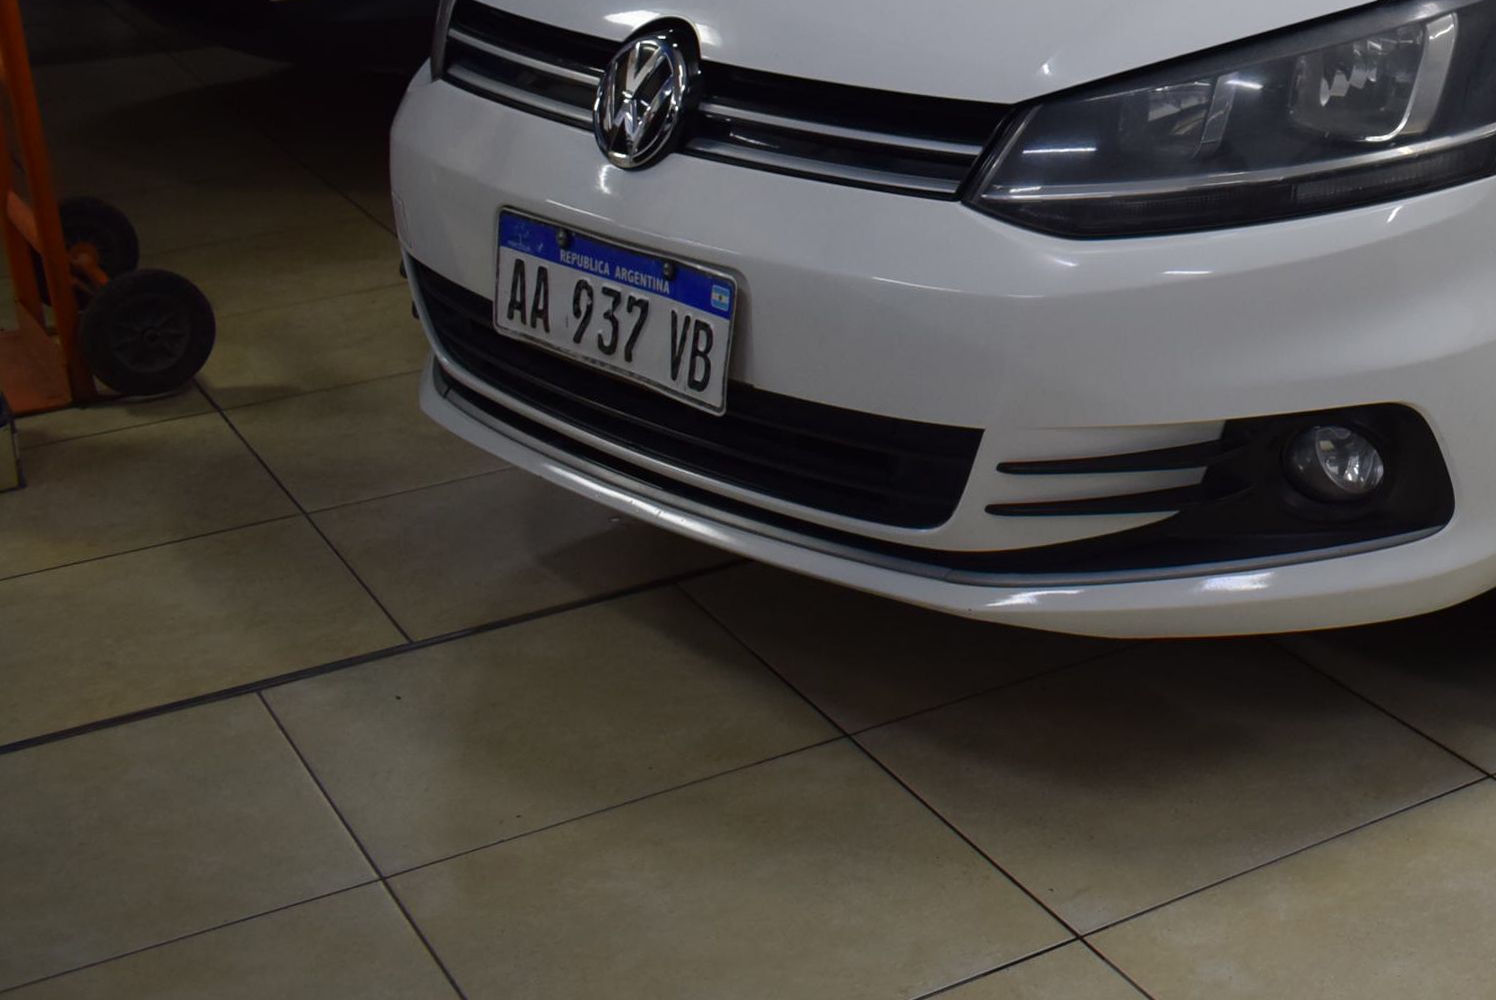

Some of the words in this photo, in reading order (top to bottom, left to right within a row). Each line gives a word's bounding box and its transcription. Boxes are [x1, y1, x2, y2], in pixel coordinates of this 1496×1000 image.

[560, 250, 610, 275] REPUBLICA
[614, 266, 670, 294] ARGENTINA
[507, 258, 550, 333] AA
[572, 279, 649, 363] 937
[671, 309, 713, 392] VB
